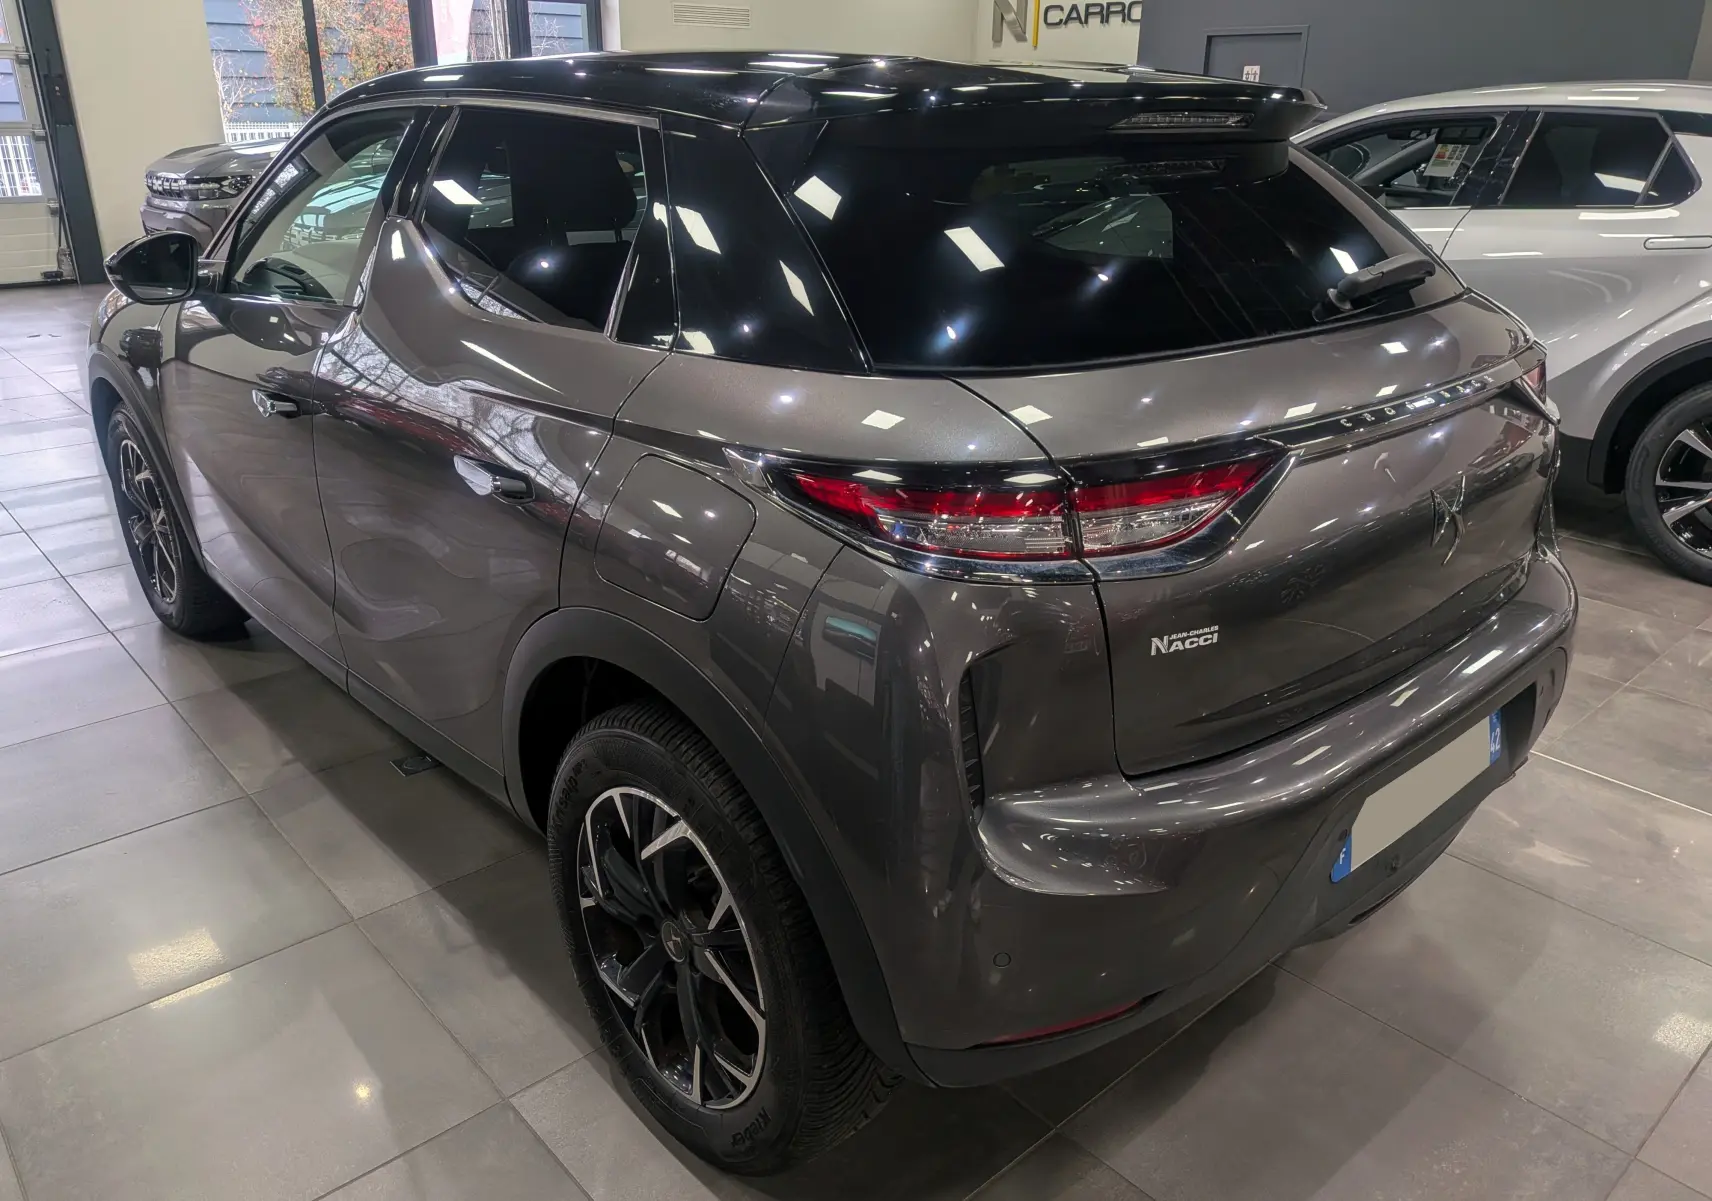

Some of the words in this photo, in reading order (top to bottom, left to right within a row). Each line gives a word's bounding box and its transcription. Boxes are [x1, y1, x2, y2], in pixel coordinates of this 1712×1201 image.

[992, 0, 1028, 42] N
[1169, 625, 1219, 640] JEAN-CHARLES
[1151, 633, 1218, 656] NACCI
[1490, 727, 1500, 753] 42
[1339, 847, 1346, 865] F
